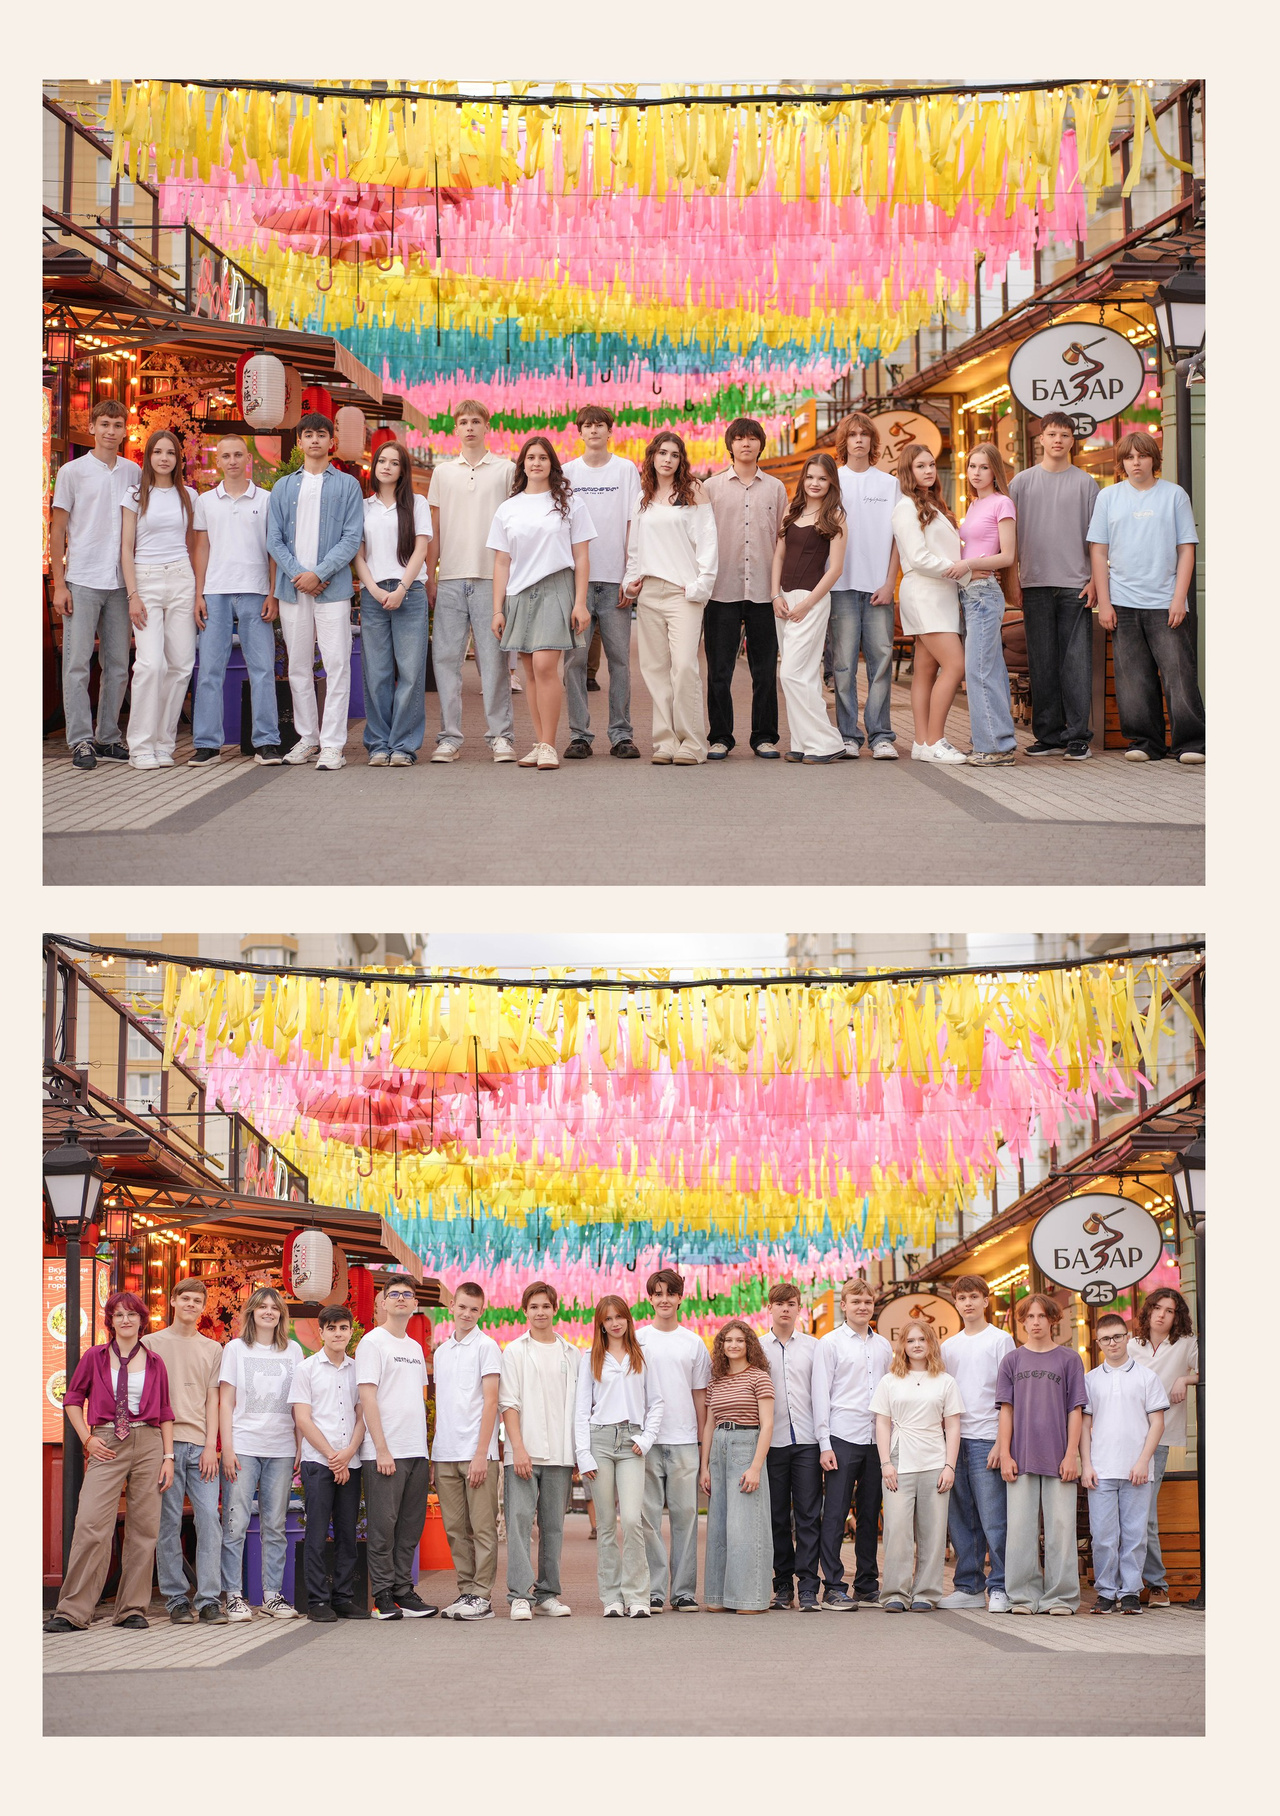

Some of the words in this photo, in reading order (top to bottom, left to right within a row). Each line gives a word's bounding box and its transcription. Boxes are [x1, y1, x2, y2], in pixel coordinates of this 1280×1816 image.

[1032, 366, 1124, 406] БАЗАР
[1054, 1235, 1143, 1274] БАЗАР
[1085, 1284, 1114, 1303] 25
[1012, 1370, 1062, 1385] ATEFUL
